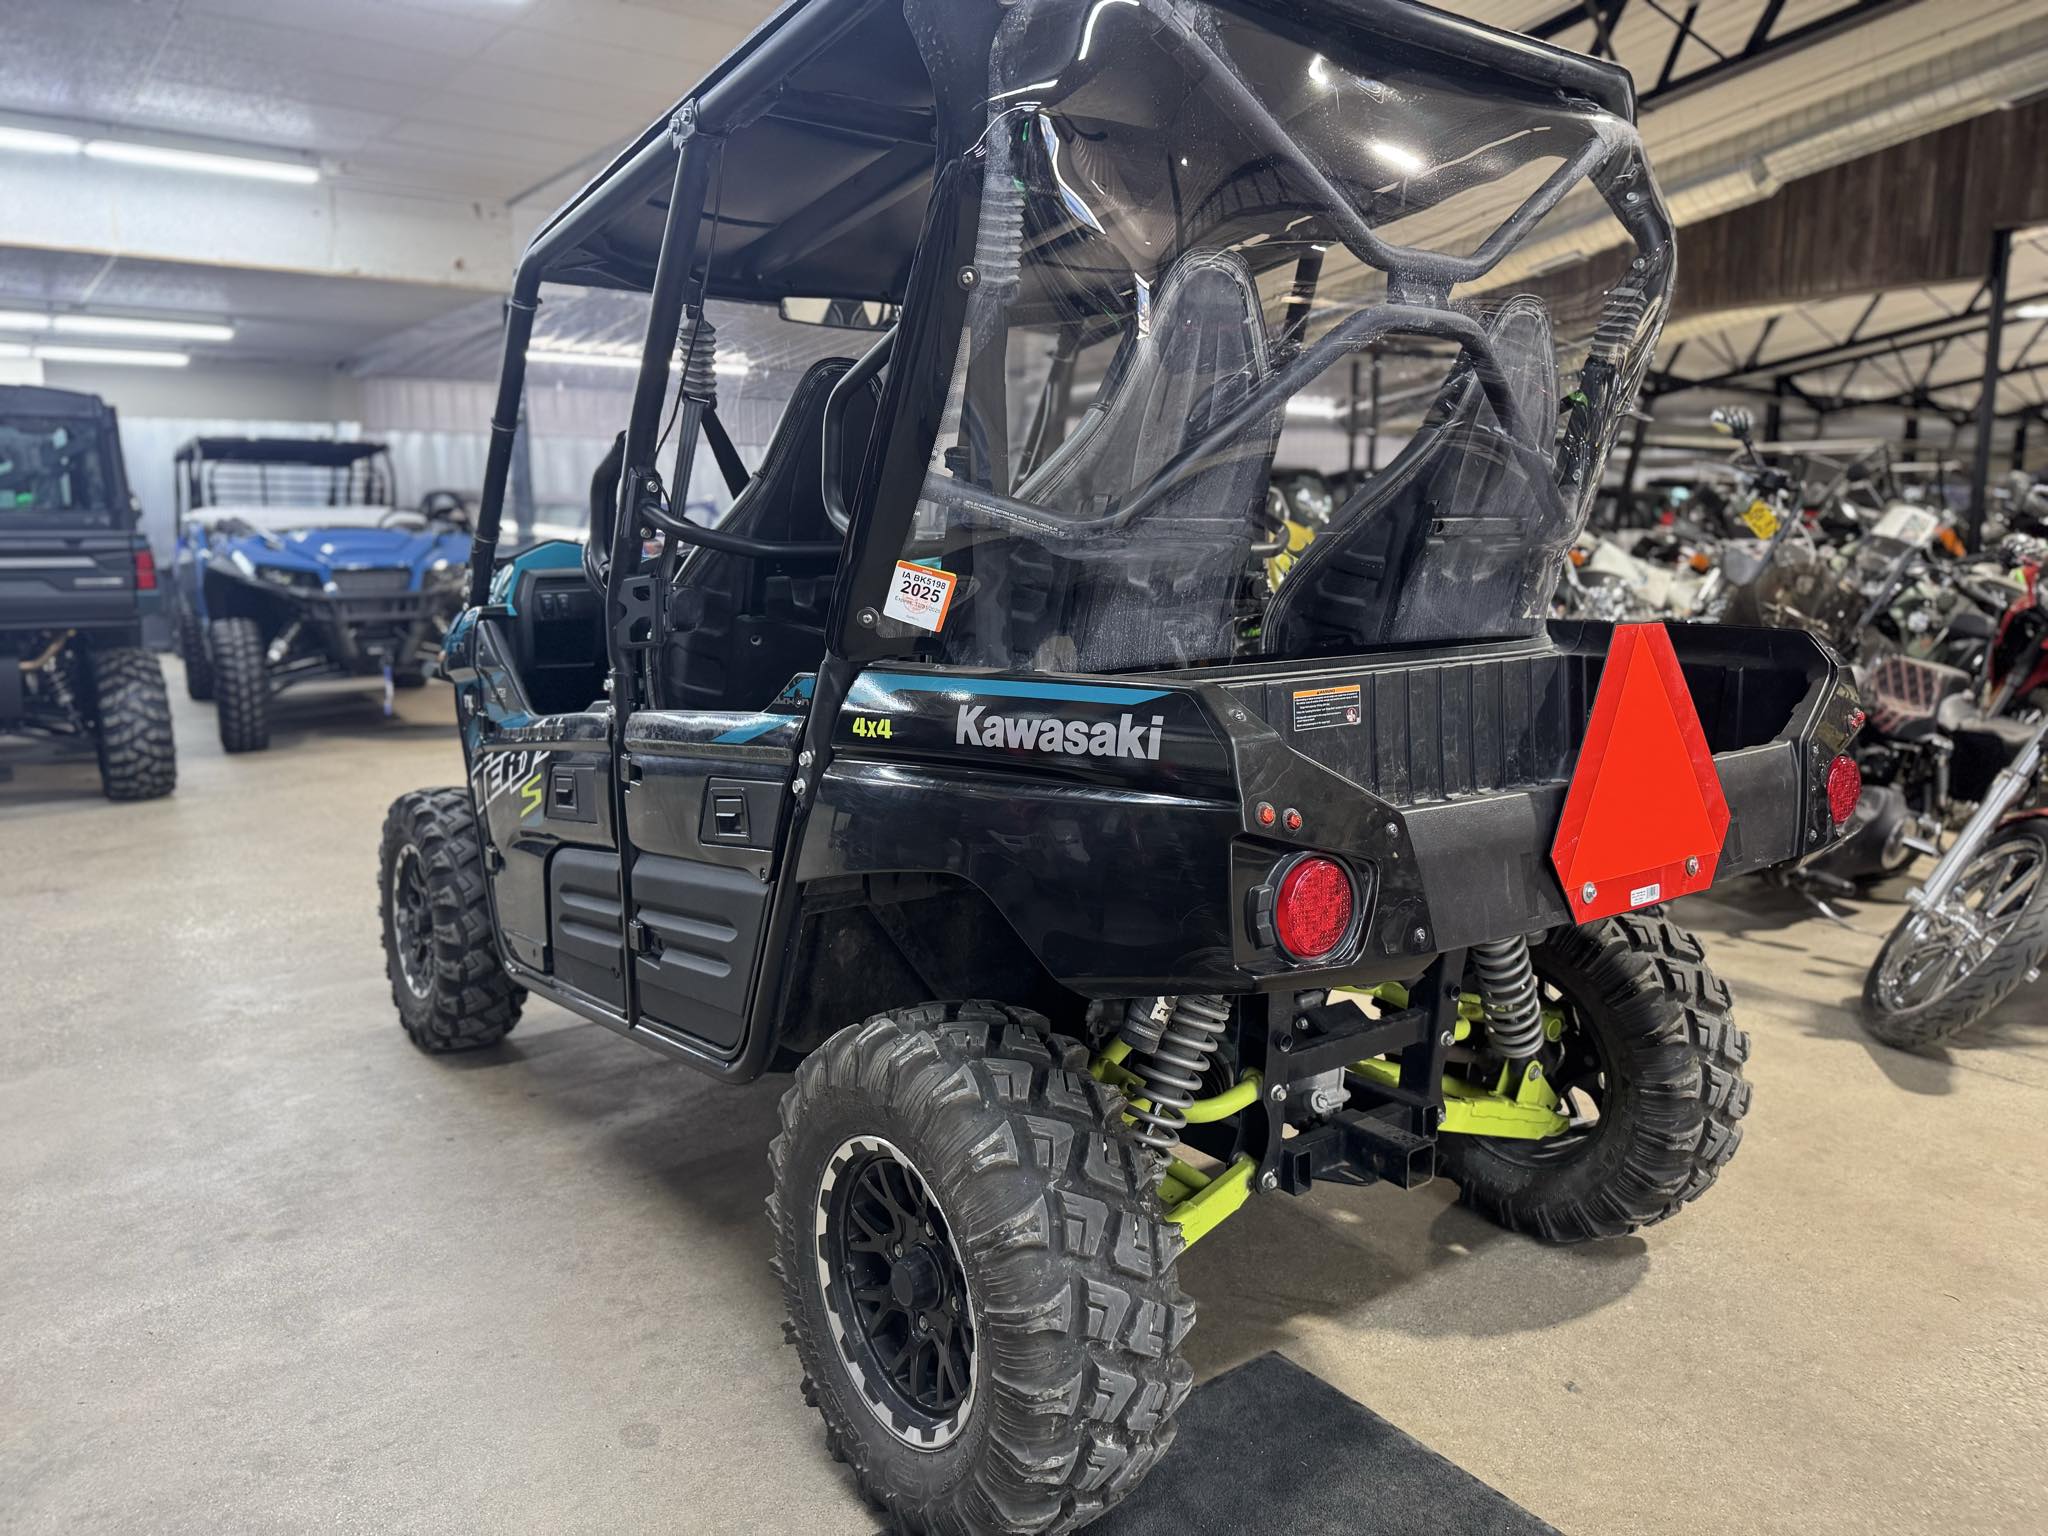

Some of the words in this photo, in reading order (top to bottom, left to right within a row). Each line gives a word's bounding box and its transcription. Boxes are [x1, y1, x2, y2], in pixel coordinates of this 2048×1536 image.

[900, 580, 941, 603] 2025
[902, 571, 911, 579] IA
[913, 574, 947, 590] BK5198
[852, 717, 893, 739] 4x4
[956, 704, 1165, 760] Kawasaki
[520, 772, 543, 818] S
